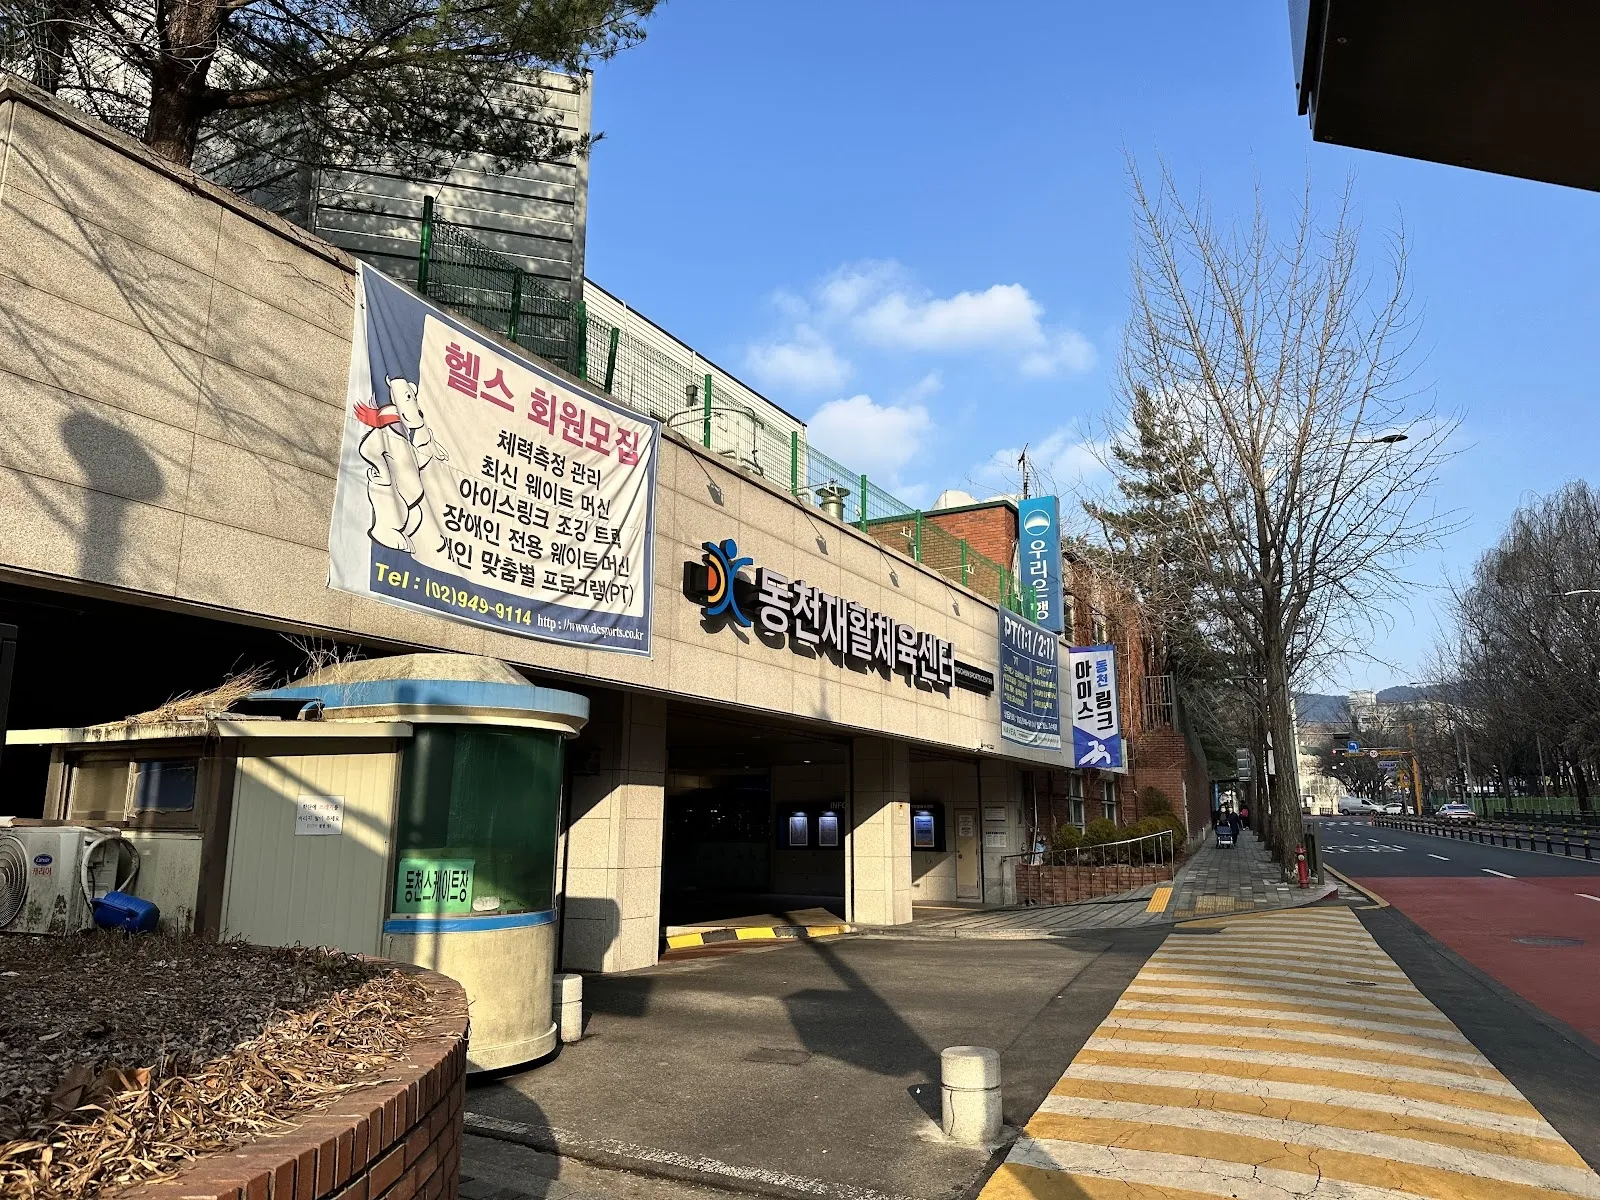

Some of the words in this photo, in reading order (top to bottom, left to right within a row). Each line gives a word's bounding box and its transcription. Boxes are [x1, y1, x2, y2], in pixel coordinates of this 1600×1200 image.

[445, 342, 515, 413] 헬스
[527, 387, 640, 467] 회원모집
[481, 454, 519, 490] 최신
[525, 473, 574, 509] 웨이트
[581, 494, 611, 521] 머신
[497, 429, 566, 478] 체력측정
[570, 460, 601, 491] 관리
[443, 503, 500, 547] 장애인
[508, 528, 543, 560] 전용
[550, 541, 598, 570] 웨이트
[601, 554, 630, 577] 머신
[459, 478, 550, 530] 아이스링크
[556, 514, 589, 542] 조깅
[375, 562, 409, 589] Tel
[424, 578, 532, 626] (02)949-9114
[436, 534, 473, 570] 개인
[481, 550, 535, 588] 맞춤별
[541, 570, 634, 607] 프로그램(PT)
[757, 567, 957, 687] 동천재활체육센터
[1075, 660, 1094, 720] 아이스
[1096, 659, 1109, 688] 동천
[1096, 690, 1114, 731] 링크
[405, 869, 469, 903] 동천스케이트장
